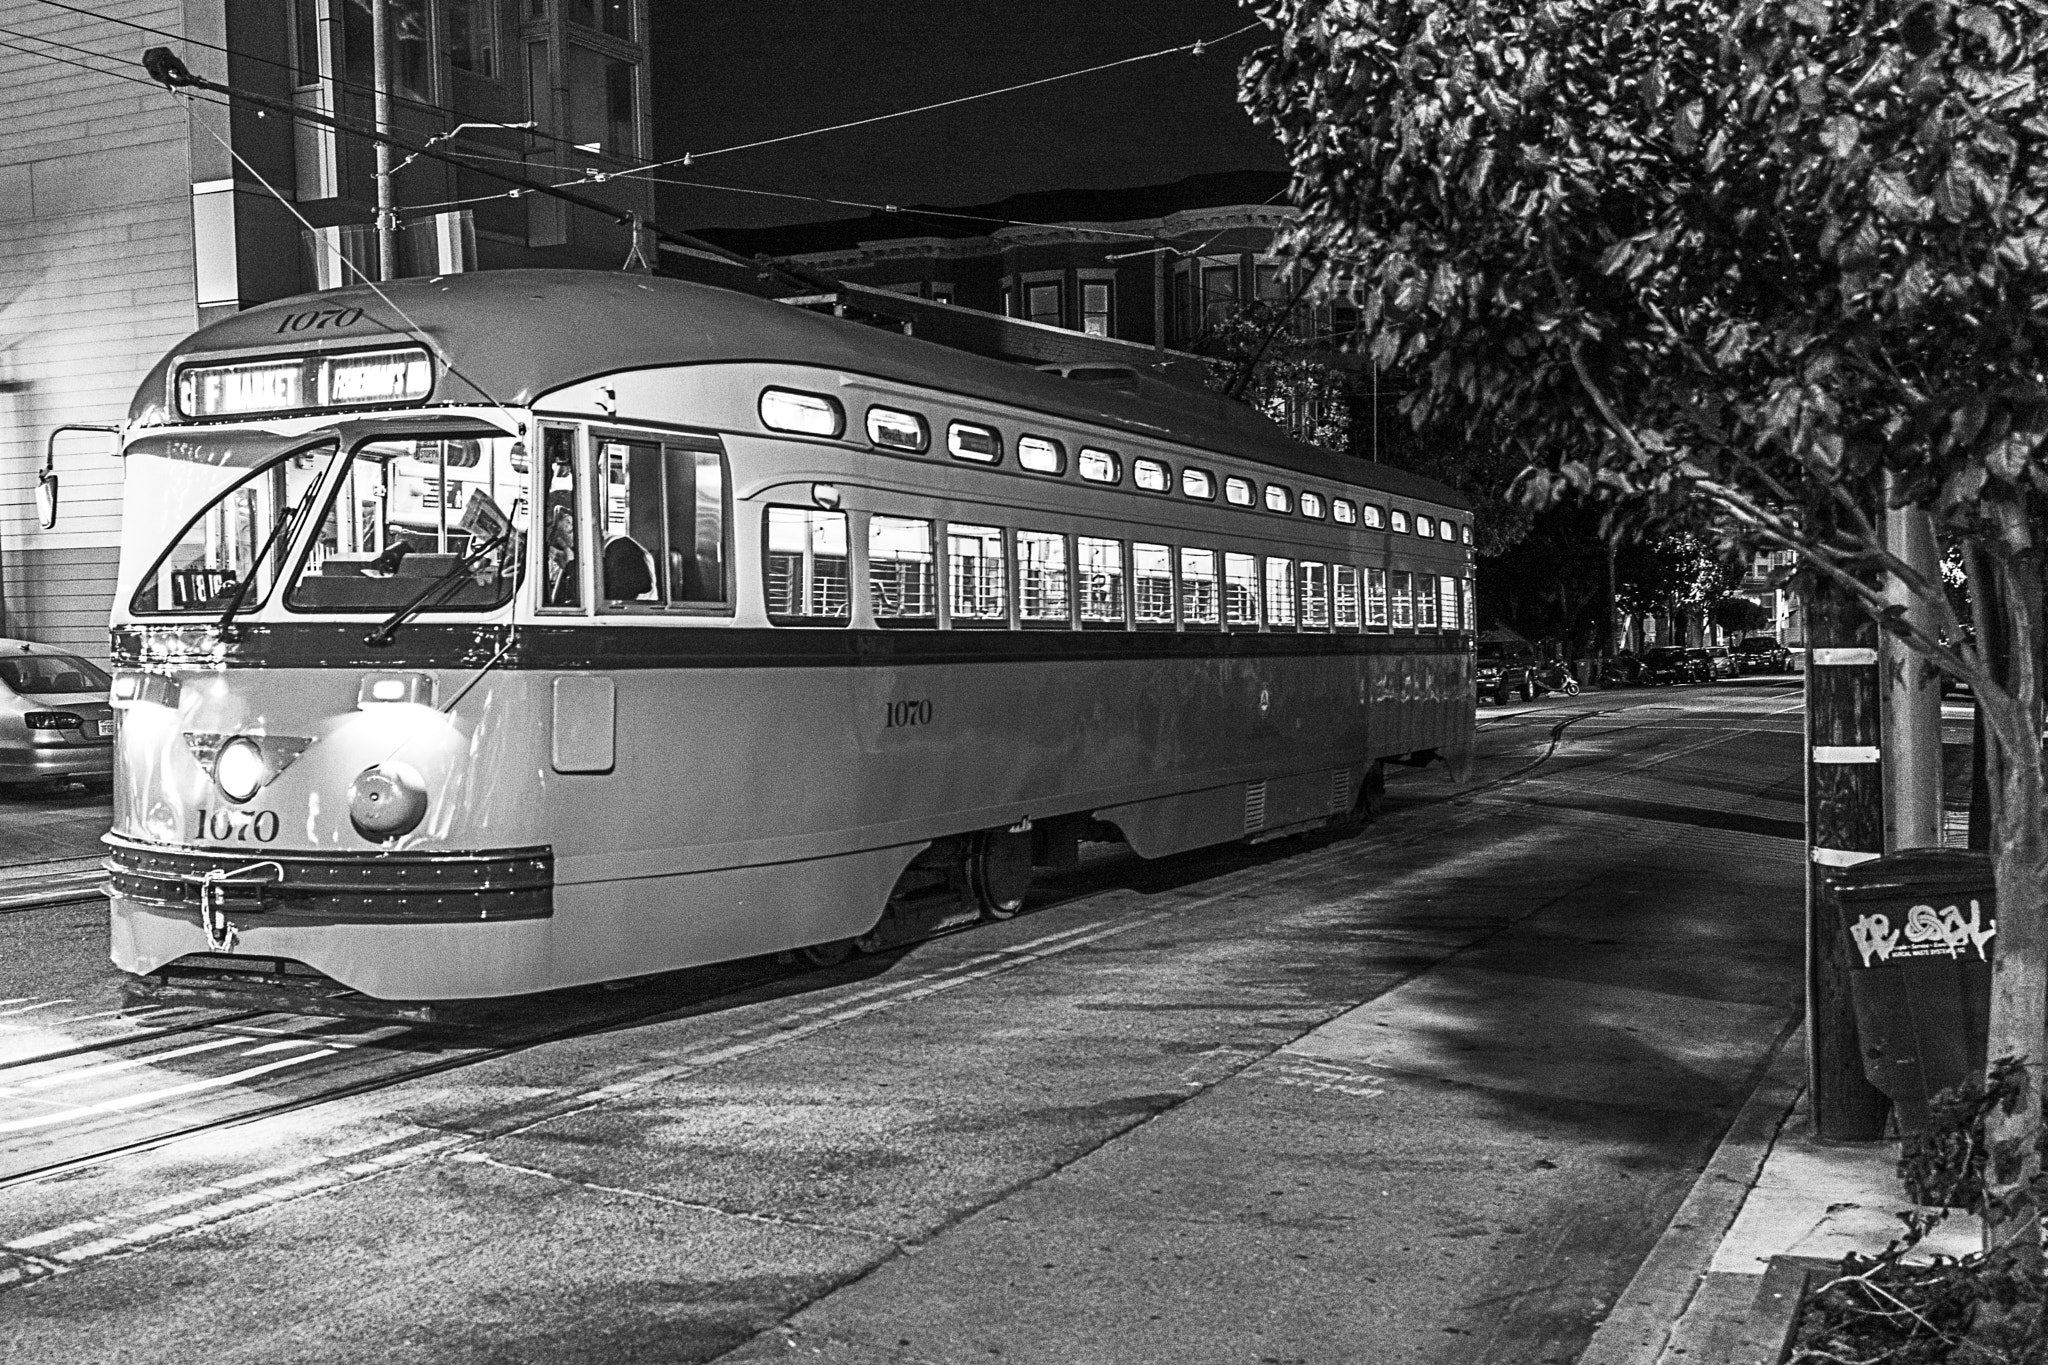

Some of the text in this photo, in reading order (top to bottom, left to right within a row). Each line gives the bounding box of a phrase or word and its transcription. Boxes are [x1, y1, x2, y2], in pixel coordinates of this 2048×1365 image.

[273, 307, 364, 334] 1070
[205, 376, 220, 413] F
[225, 368, 298, 411] MARKET
[886, 699, 932, 728] 1070
[193, 809, 280, 842] 1070
